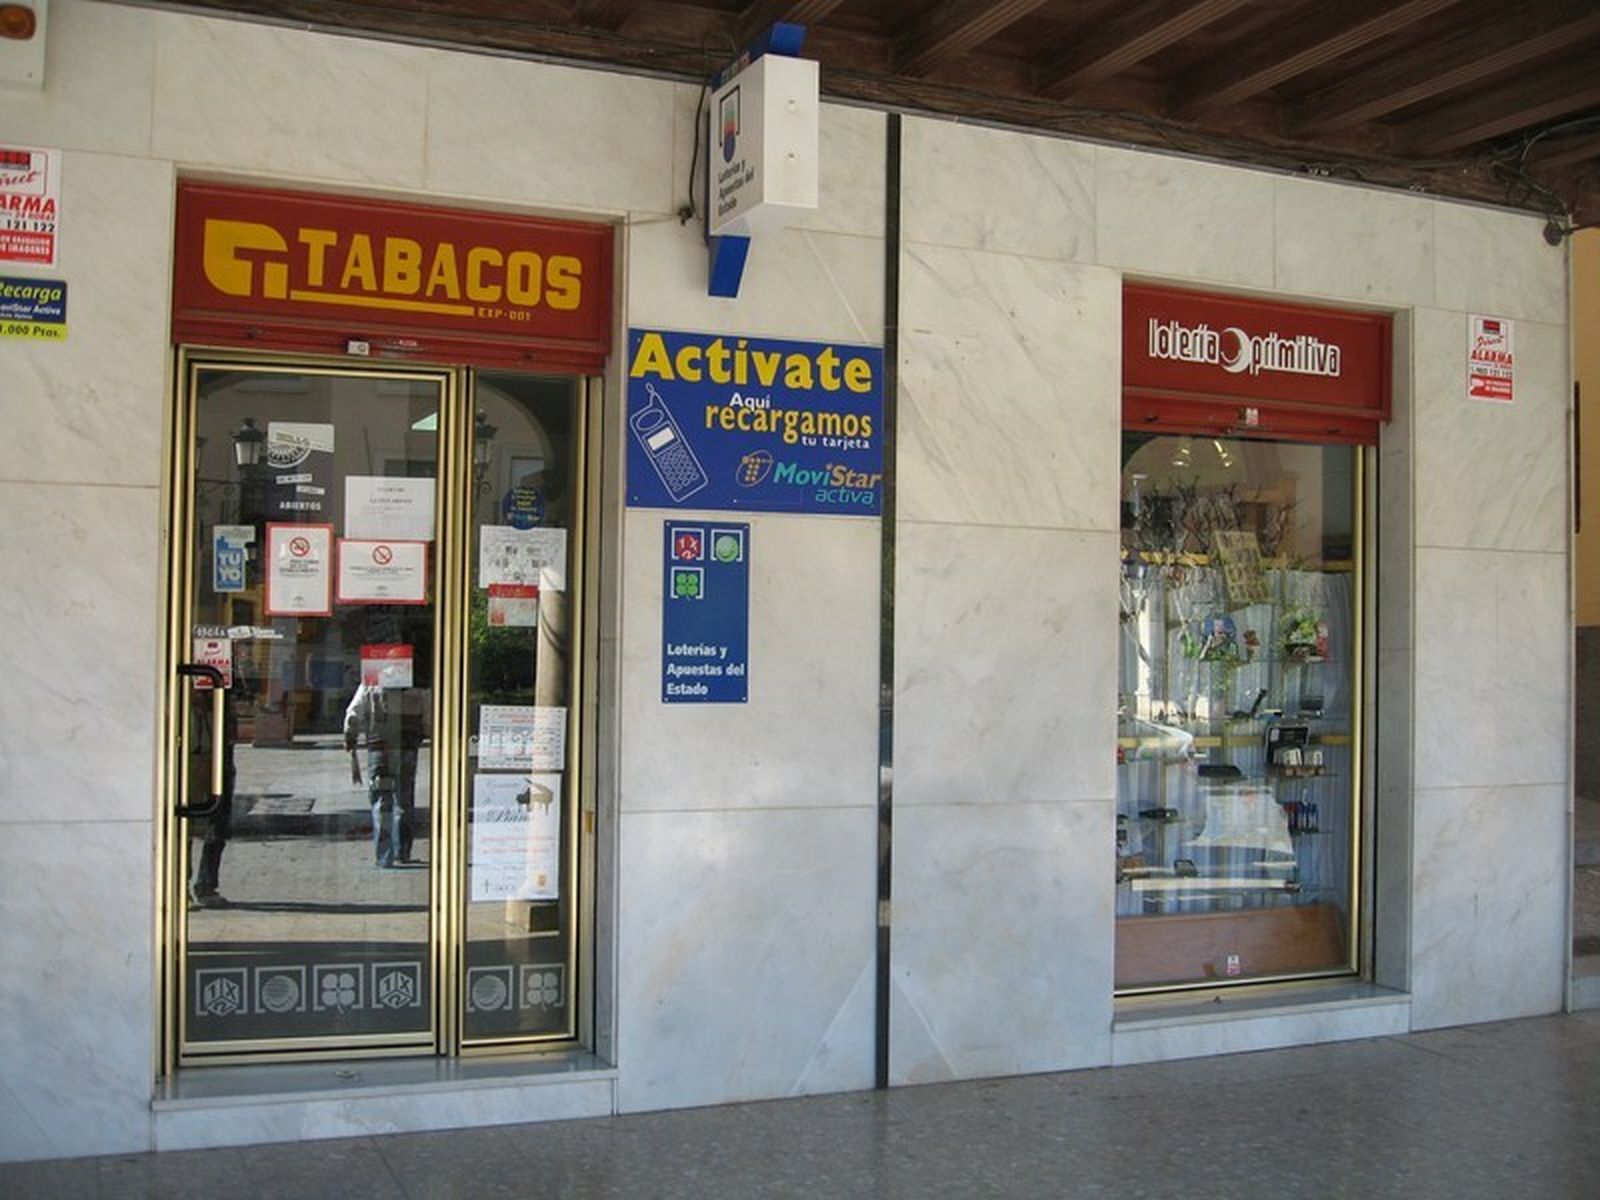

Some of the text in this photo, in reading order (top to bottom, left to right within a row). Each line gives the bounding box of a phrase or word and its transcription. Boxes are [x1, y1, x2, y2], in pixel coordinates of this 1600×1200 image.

[297, 227, 583, 311] TABACOS
[705, 404, 873, 444] recargamos
[802, 436, 871, 451] tu tarjeta
[773, 462, 882, 489] MoviStar
[815, 486, 875, 505] activa
[719, 647, 728, 660] y
[666, 663, 745, 678] Apuestas del
[666, 682, 709, 695] Estado
